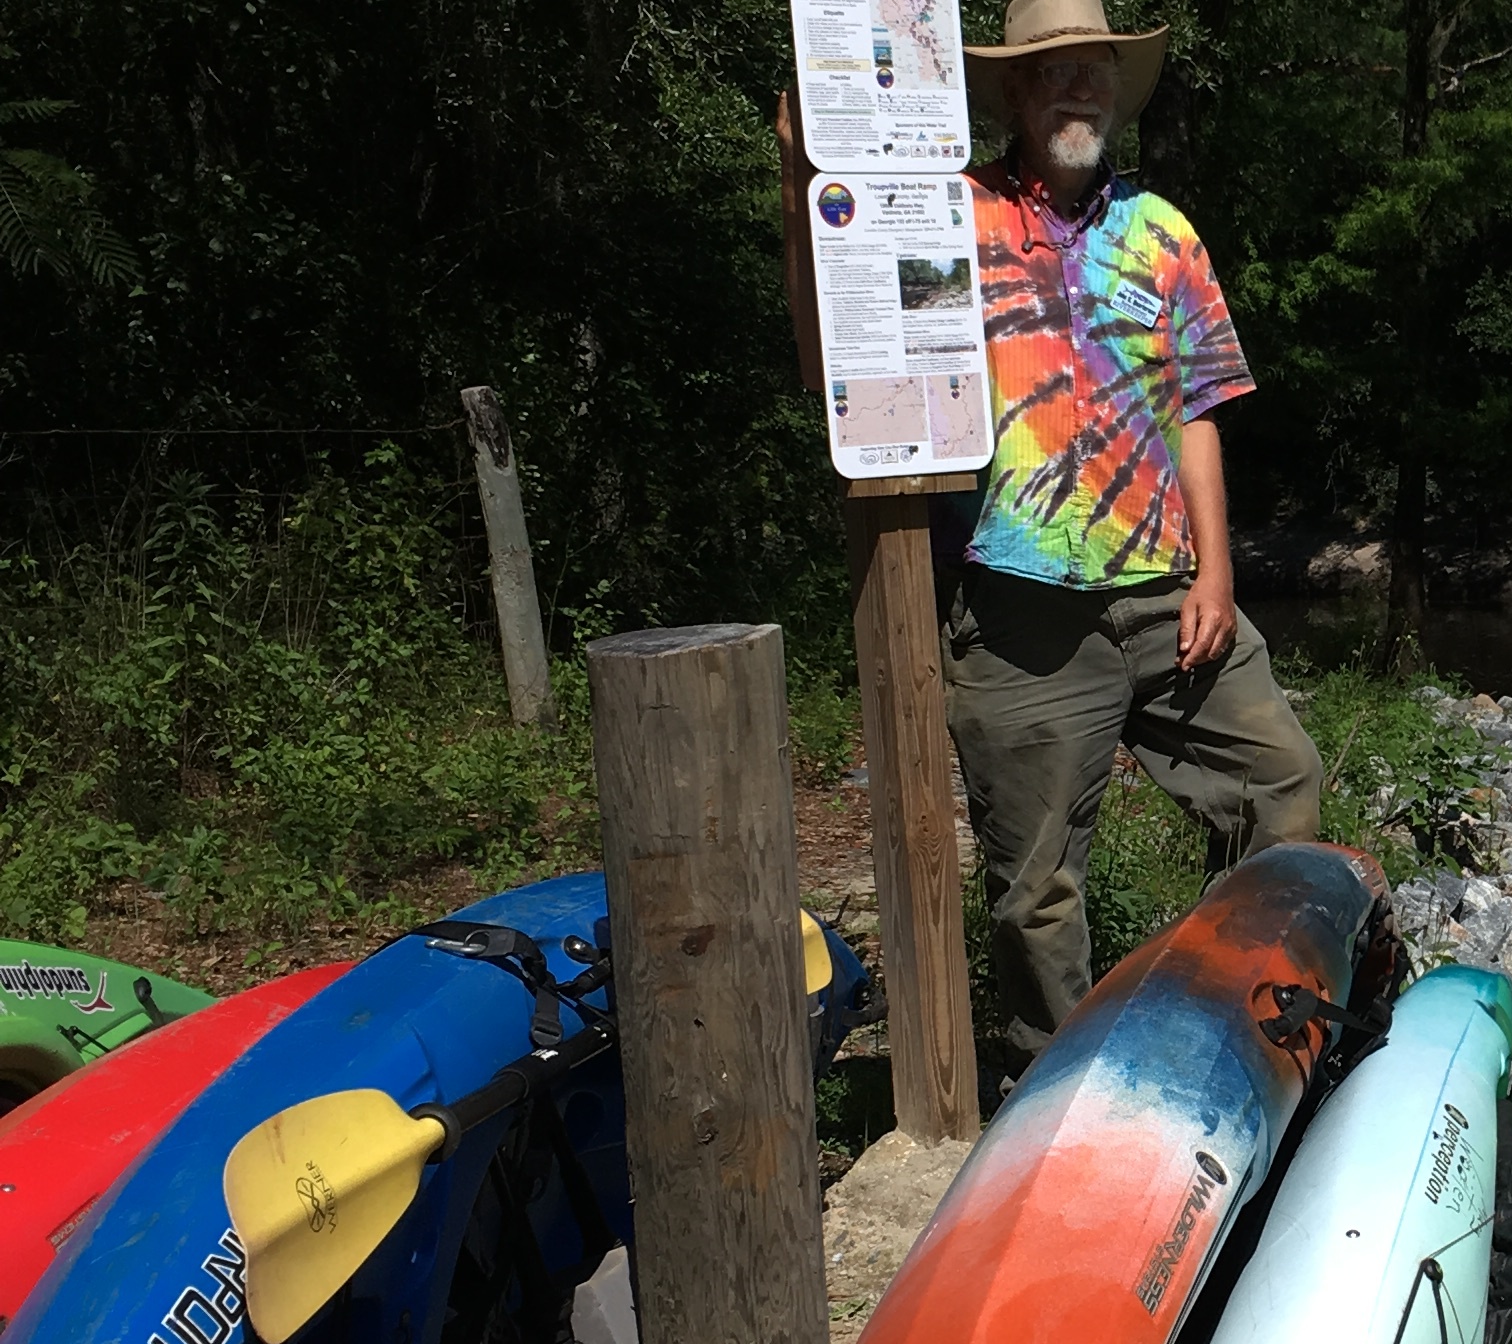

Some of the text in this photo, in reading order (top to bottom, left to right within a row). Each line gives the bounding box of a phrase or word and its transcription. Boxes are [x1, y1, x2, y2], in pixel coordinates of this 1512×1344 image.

[865, 183, 899, 191] Troupville
[918, 183, 937, 191] Ramp
[306, 1160, 337, 1234] WERNER
[1424, 1115, 1460, 1205] perception
[1143, 1174, 1216, 1317] WILDERNESS
